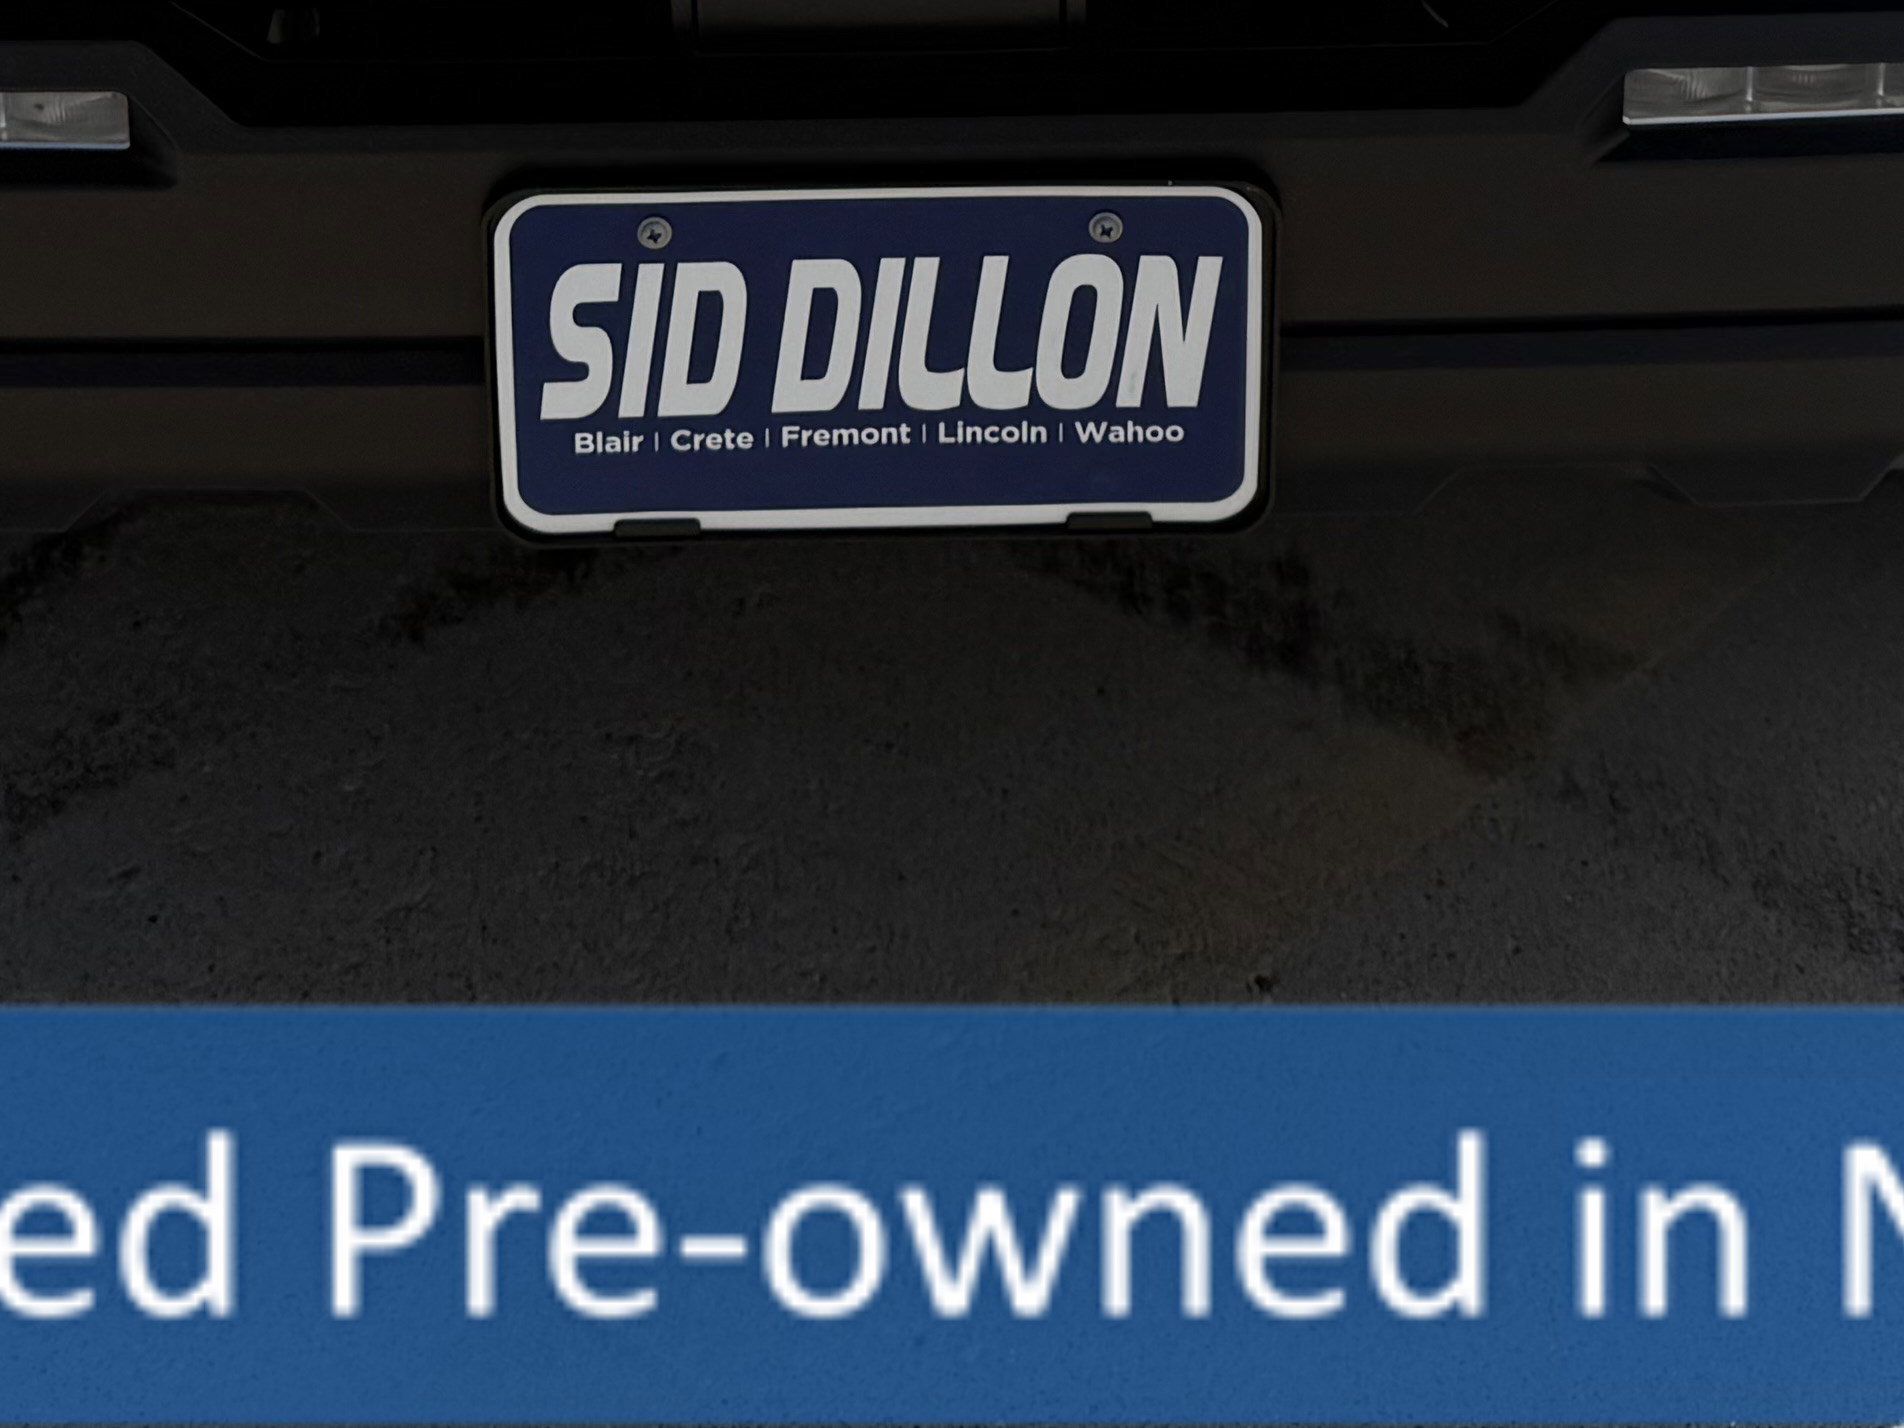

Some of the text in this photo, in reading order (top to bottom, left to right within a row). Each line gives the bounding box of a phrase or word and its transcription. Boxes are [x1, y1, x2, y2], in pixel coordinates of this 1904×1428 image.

[539, 253, 1224, 421] SID DILLON
[574, 419, 1185, 455] Blair Crete Fremont Lincoln Wahoo
